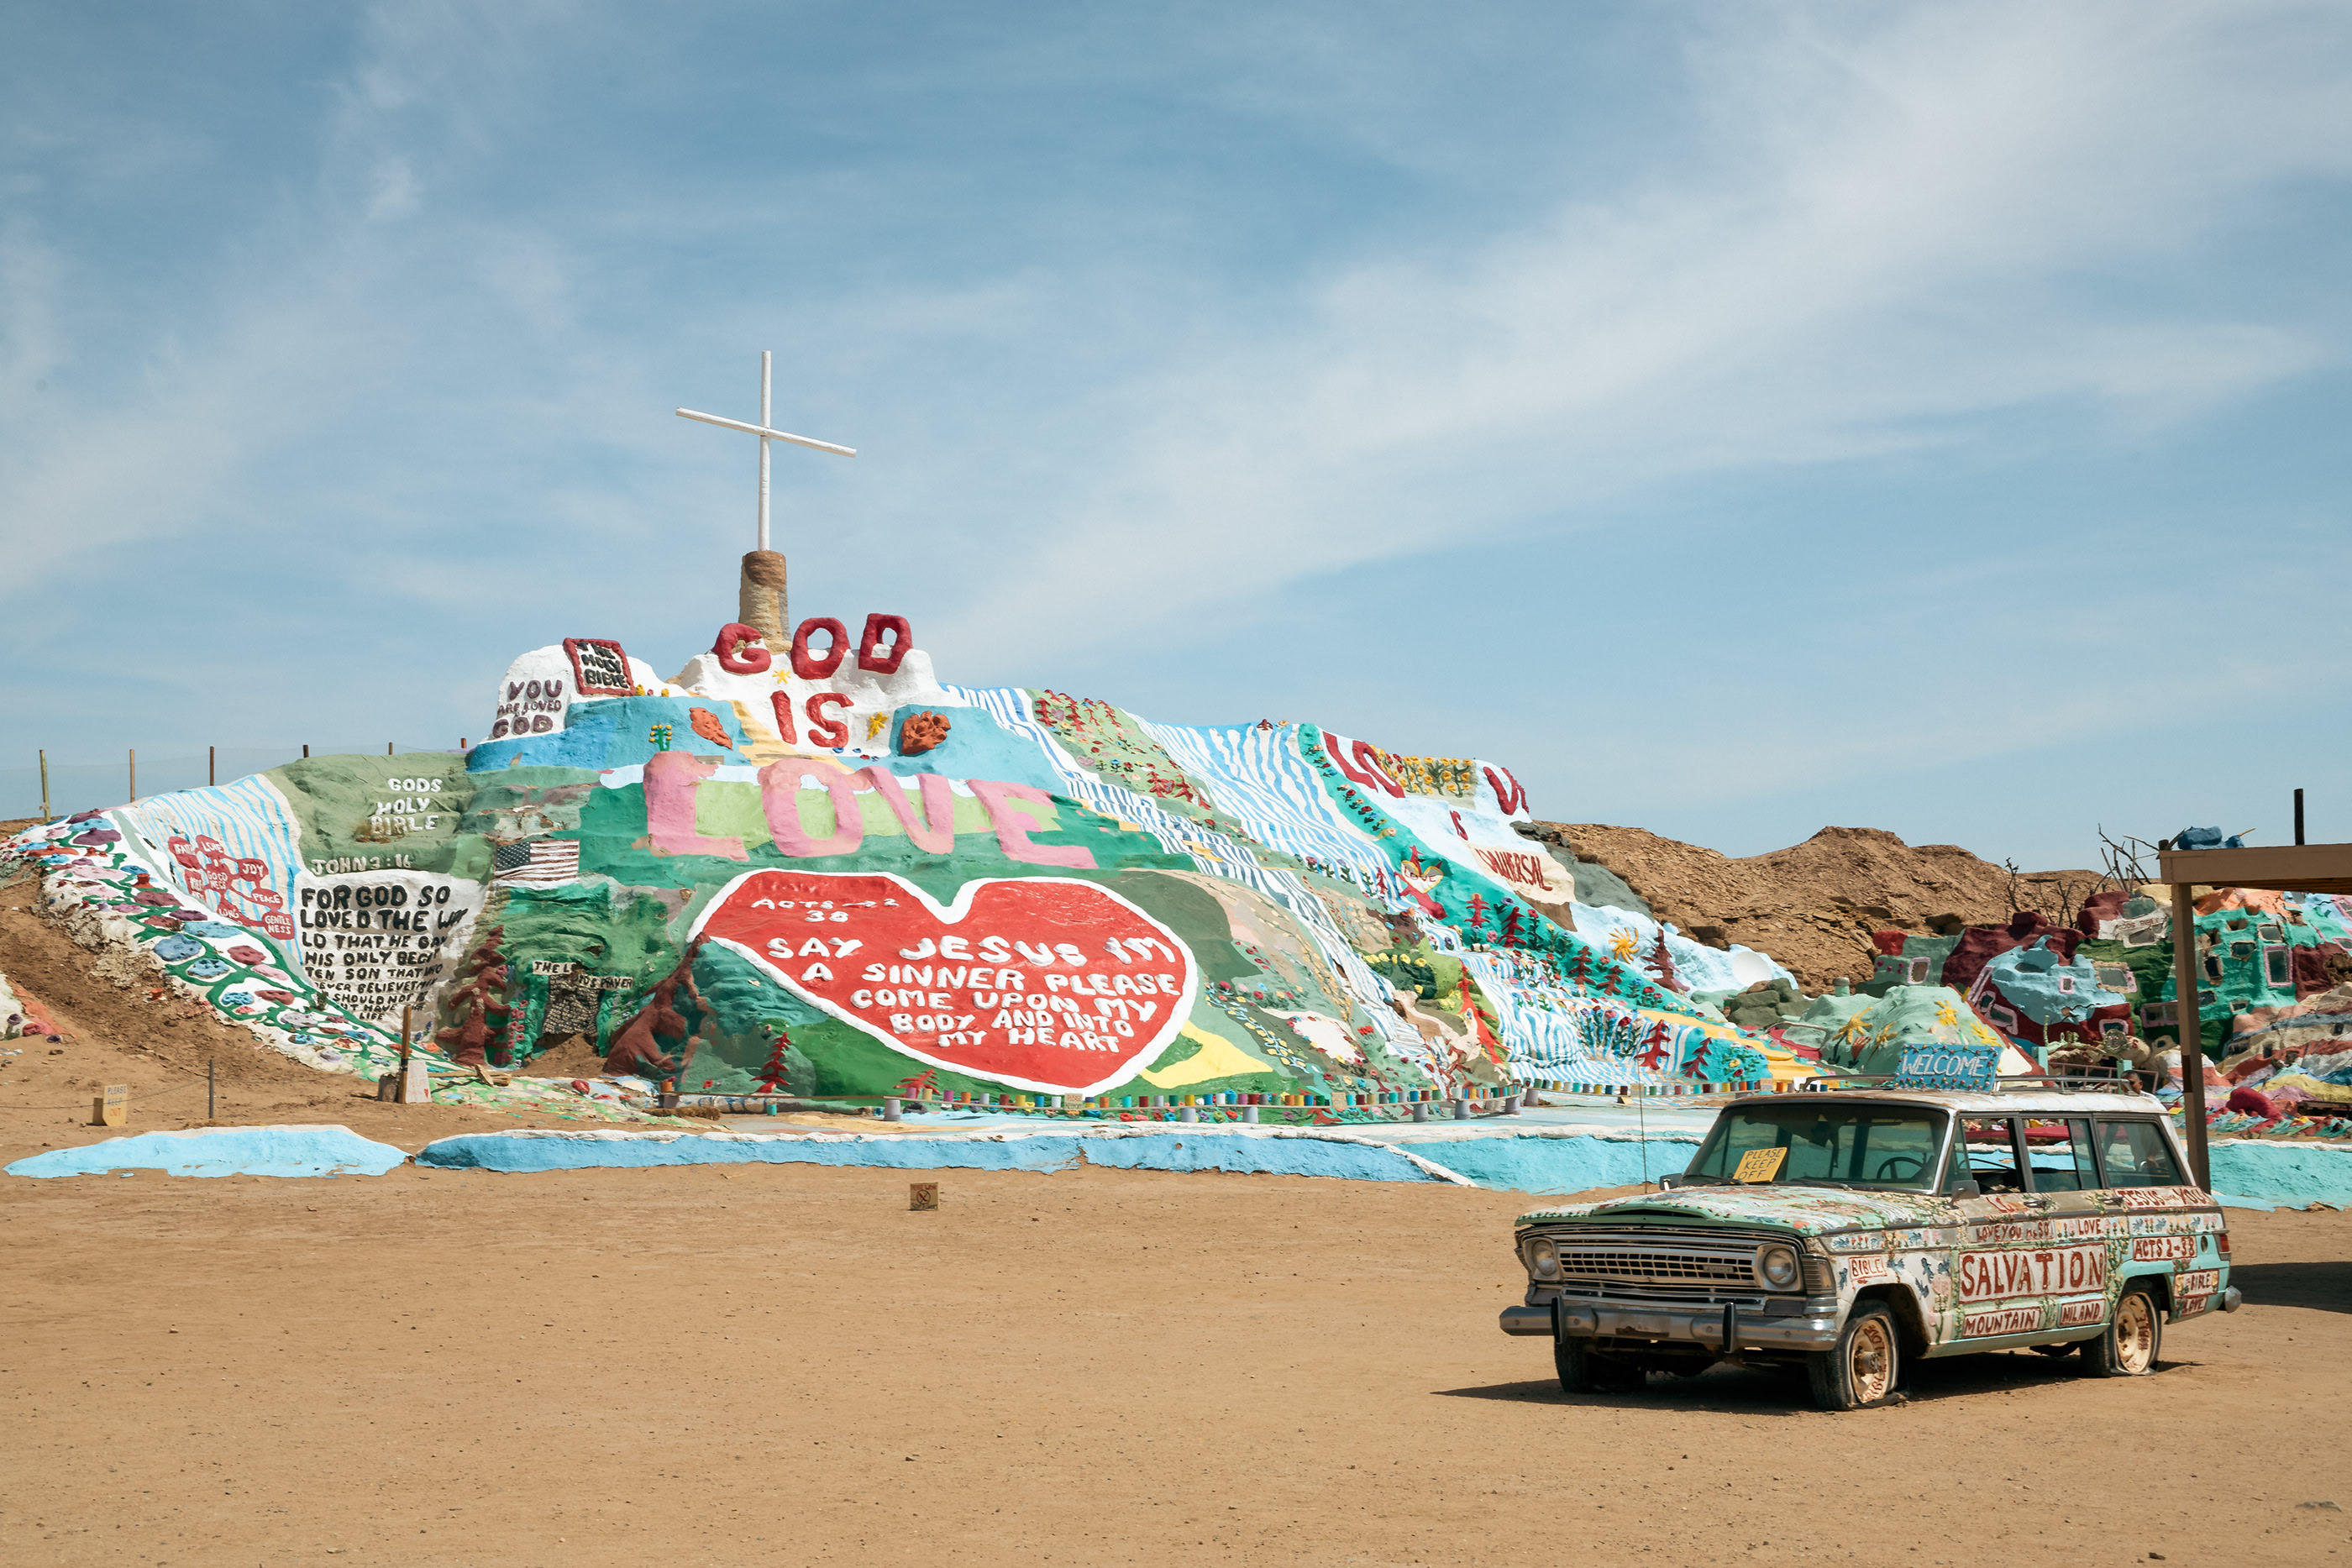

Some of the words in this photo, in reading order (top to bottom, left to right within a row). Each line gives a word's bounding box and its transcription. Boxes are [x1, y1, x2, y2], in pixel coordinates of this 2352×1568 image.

[712, 613, 913, 680] GOD
[581, 654, 622, 674] HOLY
[585, 669, 628, 688] BIBLE
[509, 679, 563, 700] YOU
[492, 714, 554, 738] GOD
[770, 690, 854, 747] IS
[388, 778, 443, 793] GODS
[375, 797, 430, 815] HOLY
[643, 751, 1098, 868] LOVE
[243, 863, 264, 878] JOY
[312, 857, 367, 875] JOHN
[1404, 868, 1436, 883] LOVE
[252, 893, 281, 904] PEACE
[302, 885, 351, 910] FOR
[356, 885, 407, 907] GOD
[417, 885, 450, 907] SO
[265, 915, 291, 926] GENTLE
[301, 910, 370, 928] LOVED
[378, 910, 429, 932] THE
[805, 910, 849, 922] 38
[268, 926, 291, 935] NESS
[302, 931, 326, 949] LD
[336, 936, 384, 949] THAT
[389, 936, 411, 947] HE
[305, 952, 334, 966] HIS
[344, 951, 391, 966] ONLY
[766, 937, 864, 959] SAY
[899, 936, 1087, 966] JESUS
[305, 968, 334, 980] TEN
[346, 968, 381, 980] SON
[387, 968, 423, 978] THAT
[534, 961, 559, 973] THE
[801, 962, 834, 981] A
[861, 962, 1026, 990] SINNER
[1044, 973, 1180, 995] PLEASE
[333, 994, 384, 1004] SHOULD
[388, 993, 413, 1004] NOT
[850, 989, 953, 1010] COME
[973, 991, 1079, 1013] UPON
[1094, 998, 1158, 1022] MY
[889, 1013, 975, 1034] BODY
[991, 1009, 1054, 1029] AND
[1062, 1011, 1134, 1037] INTO
[937, 1030, 987, 1047] MY
[1008, 1028, 1120, 1052] HEART
[1902, 1054, 1988, 1077] WELCOME
[108, 1086, 126, 1095] PLEASE
[1746, 1149, 1783, 1160] PLEASE
[1744, 1158, 1776, 1170] KEEP
[1738, 1170, 1767, 1180] OFF
[2117, 1190, 2166, 1206] JESUS
[2172, 1188, 2206, 1204] YOU
[2002, 1225, 2022, 1239] YOU
[2077, 1219, 2102, 1235] LOVE
[2134, 1239, 2163, 1258] ACTS
[1852, 1259, 1882, 1276] BIBLE
[1961, 1251, 2103, 1297] SALVATION
[2061, 1303, 2100, 1322] NILAND
[1964, 1310, 2036, 1335] MOUNTAIN
